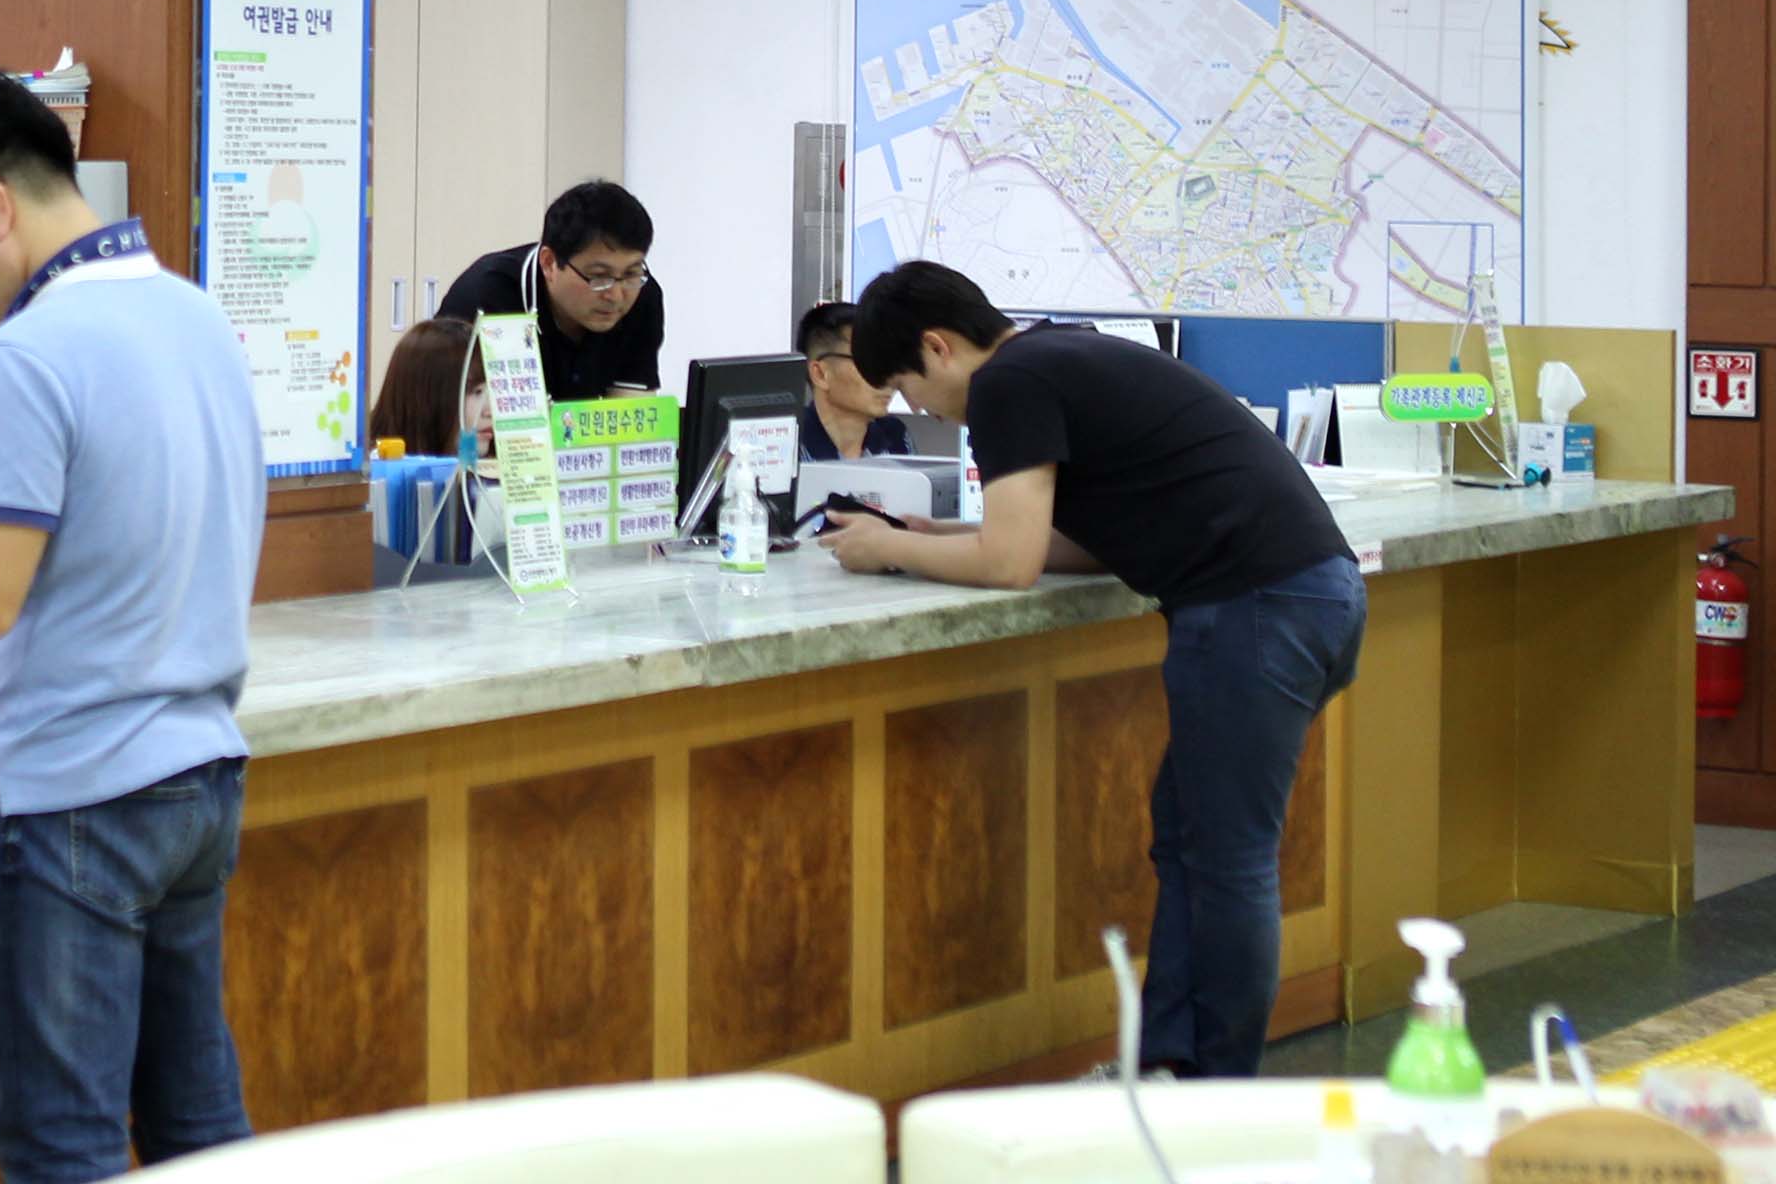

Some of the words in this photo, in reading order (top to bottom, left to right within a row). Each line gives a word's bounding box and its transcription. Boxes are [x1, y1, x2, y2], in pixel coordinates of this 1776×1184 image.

[242, 4, 300, 35] 여권발급
[305, 8, 334, 36] 안내
[1696, 355, 1751, 370] 소화기
[1391, 387, 1452, 409] 가족관계등록
[579, 406, 658, 437] 민원접수창구
